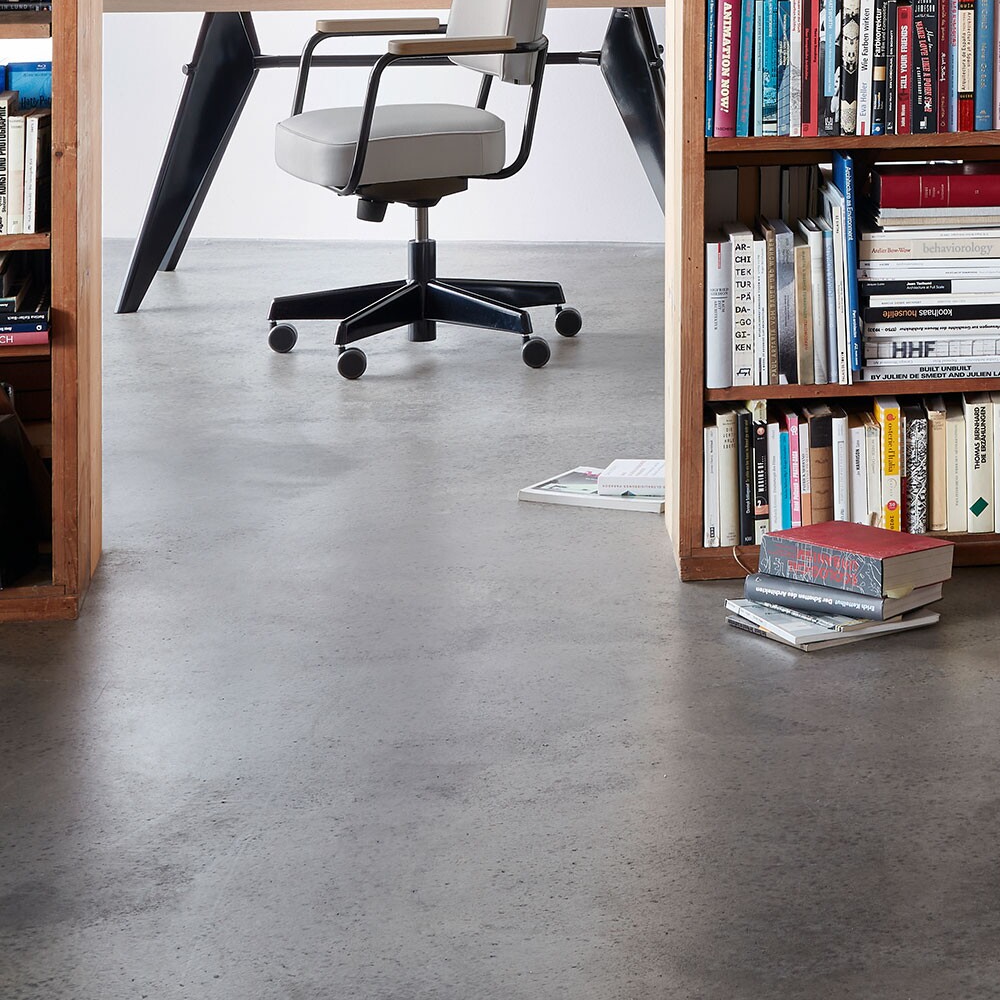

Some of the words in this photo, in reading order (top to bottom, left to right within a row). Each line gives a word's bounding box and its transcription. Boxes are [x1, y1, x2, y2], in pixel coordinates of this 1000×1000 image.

[721, 2, 732, 76] ANIMATION
[861, 32, 869, 56] Farben
[860, 57, 868, 72] Wie
[720, 78, 730, 113] NOW!
[922, 241, 993, 255] behaviorology
[882, 309, 917, 318] houselife
[918, 307, 953, 317] koolhaas
[892, 341, 936, 358] HHF
